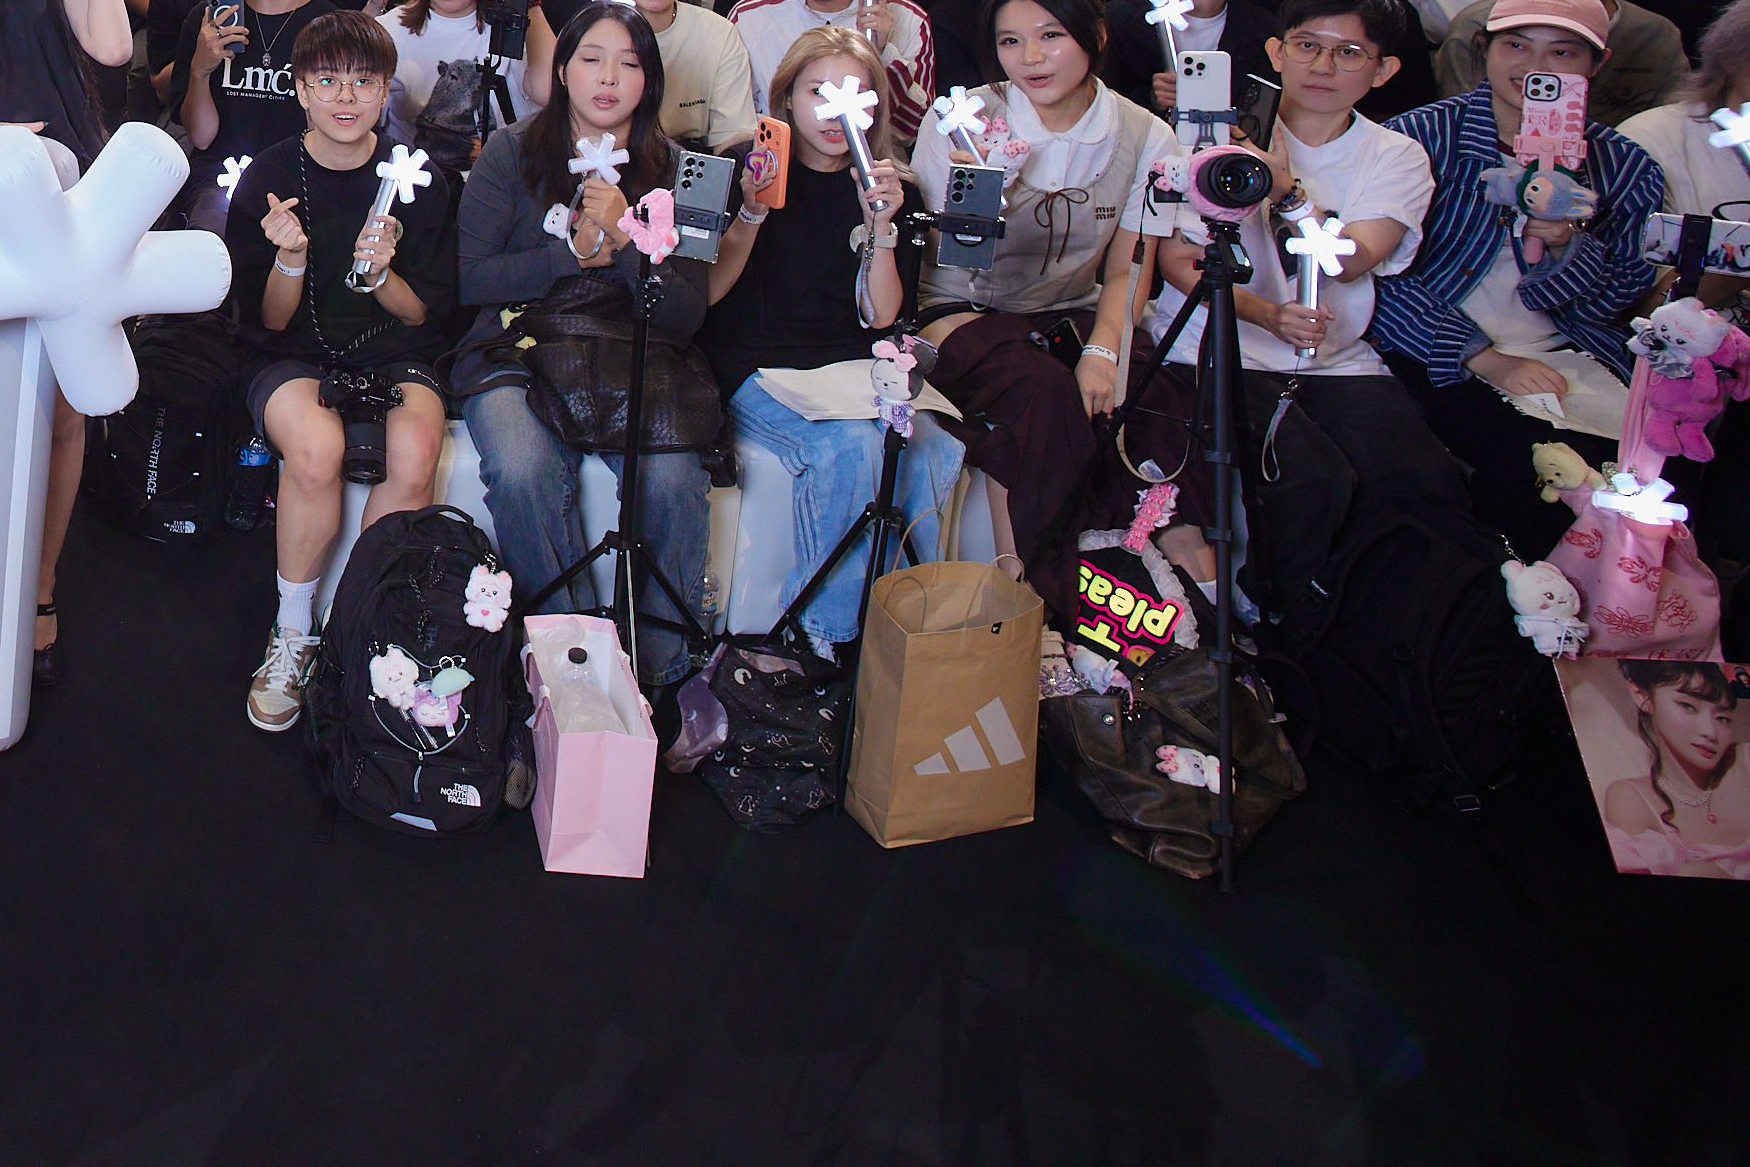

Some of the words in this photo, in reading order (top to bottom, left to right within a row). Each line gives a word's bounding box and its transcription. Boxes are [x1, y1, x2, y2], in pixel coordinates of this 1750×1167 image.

[155, 407, 167, 429] THE
[149, 429, 164, 469] NORTH
[146, 469, 158, 495] FACE
[440, 787, 468, 798] NORTH
[453, 782, 469, 792] THE
[447, 796, 468, 805] FACE
